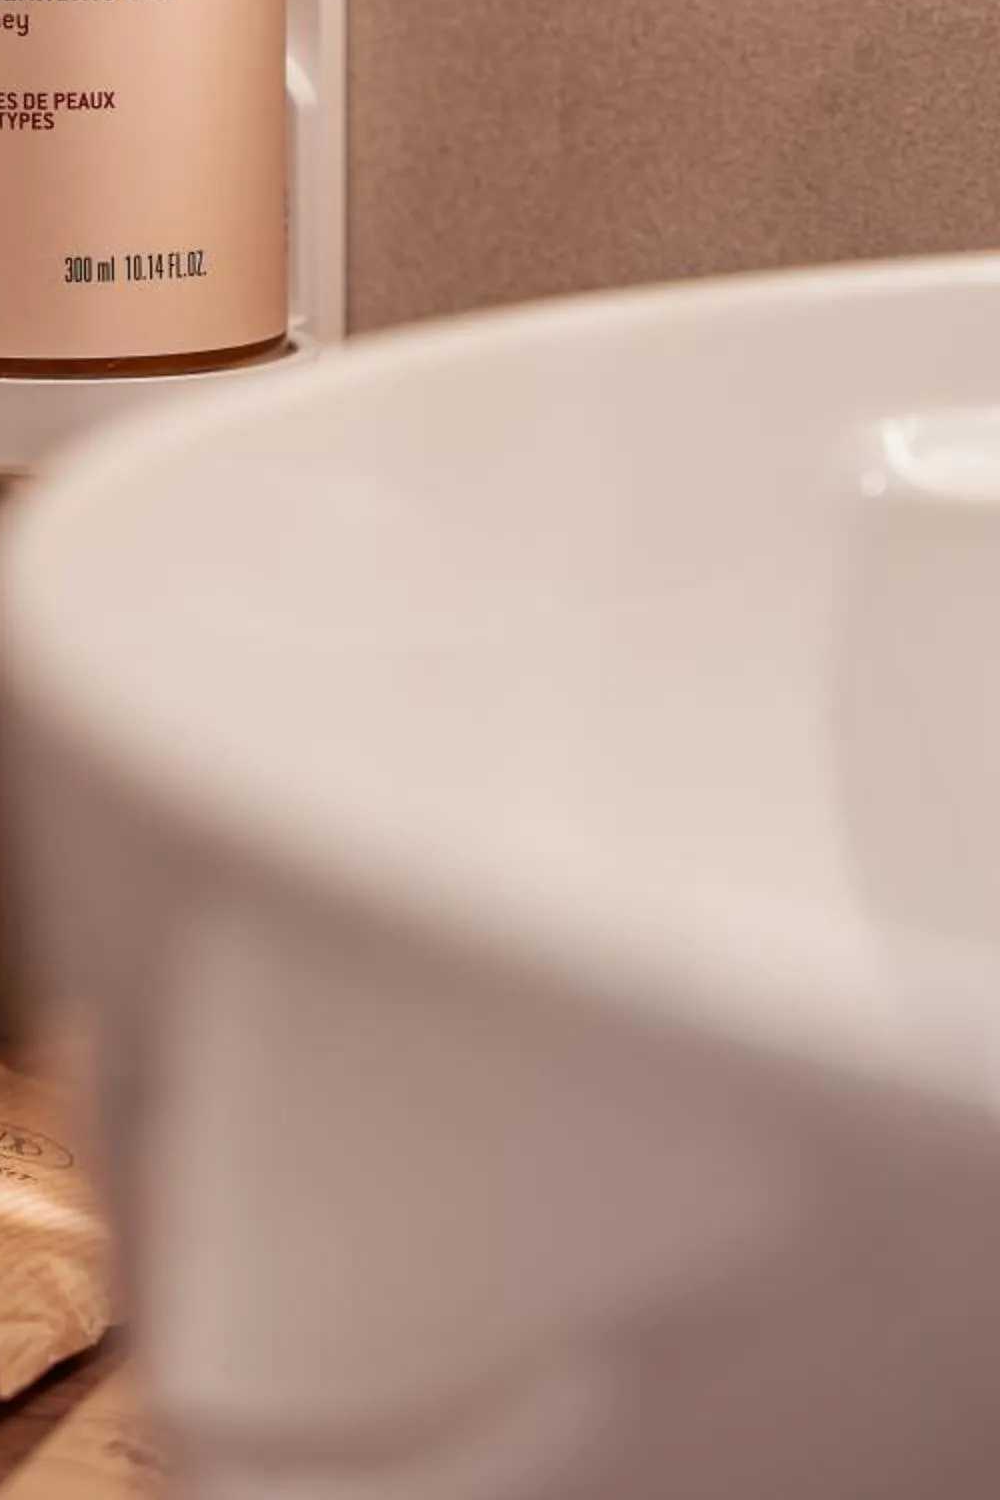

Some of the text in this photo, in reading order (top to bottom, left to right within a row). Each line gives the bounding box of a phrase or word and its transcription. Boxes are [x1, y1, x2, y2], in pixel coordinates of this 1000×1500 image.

[23, 92, 48, 111] DE
[53, 91, 116, 110] PEAUX
[64, 256, 92, 283] 300
[97, 255, 115, 283] ml
[125, 253, 165, 281] 10.14
